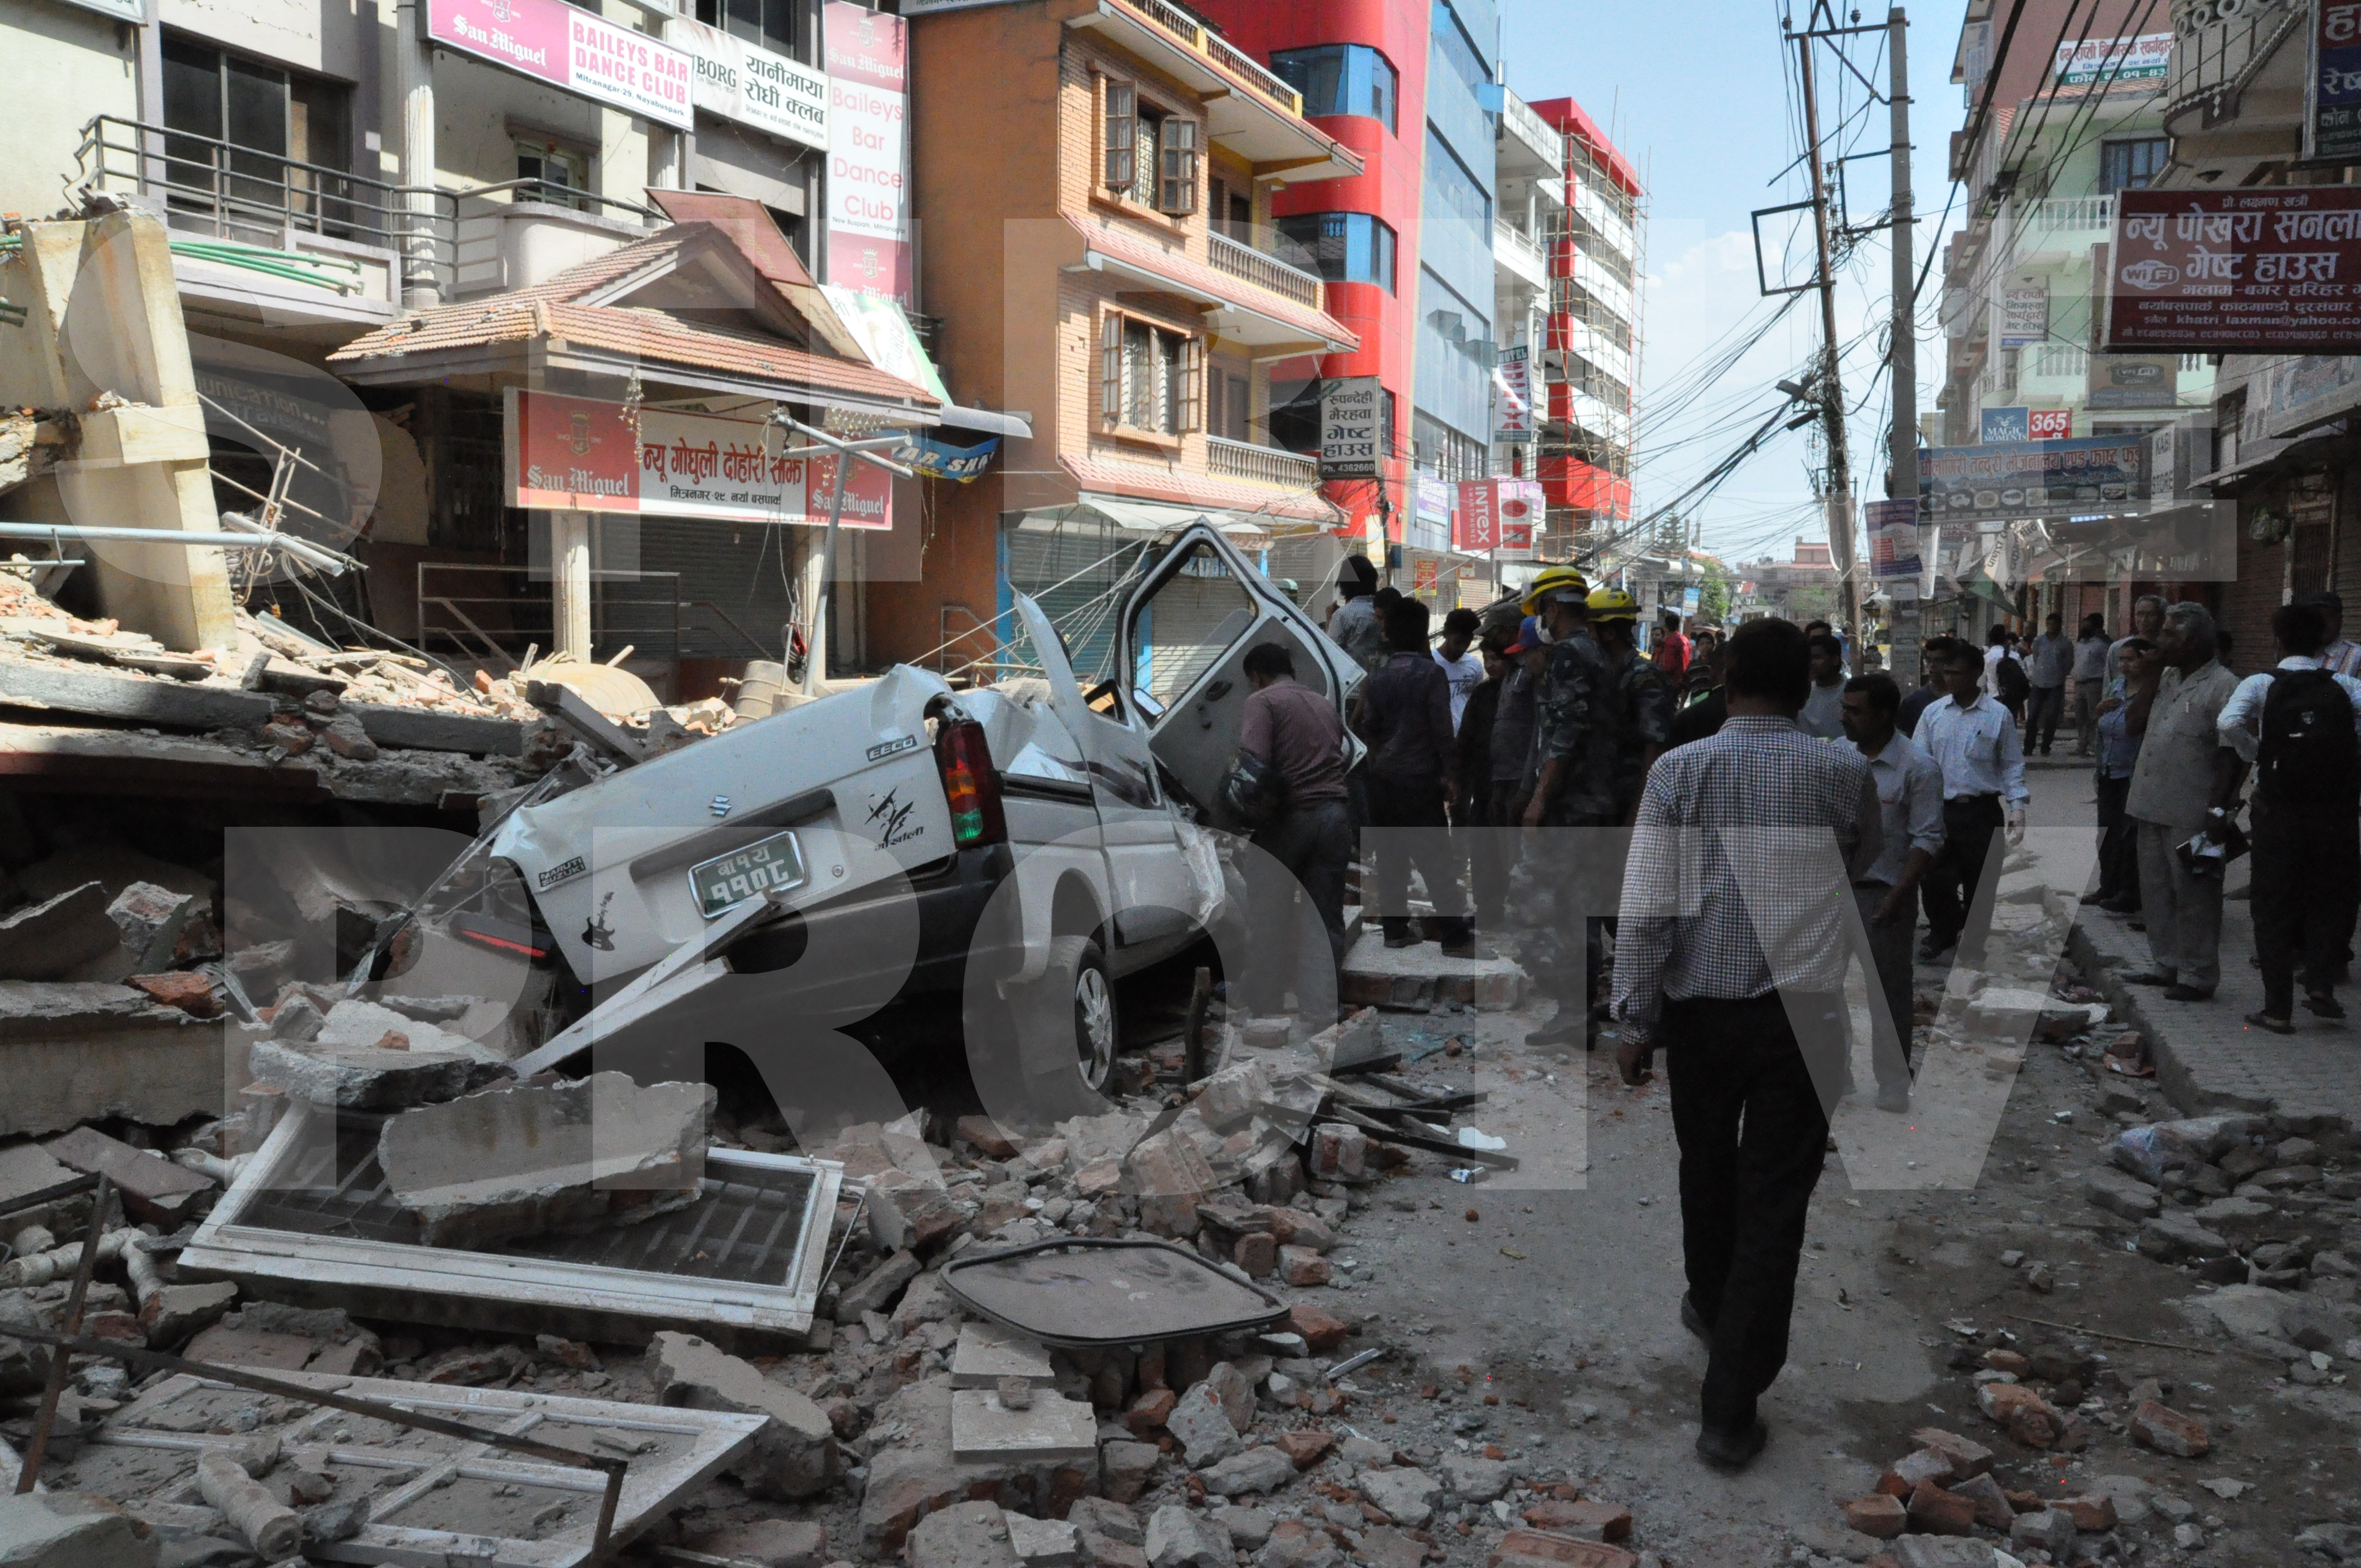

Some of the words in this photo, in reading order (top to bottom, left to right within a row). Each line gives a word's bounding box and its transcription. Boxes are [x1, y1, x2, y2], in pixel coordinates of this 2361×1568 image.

[453, 14, 488, 45] San
[490, 26, 547, 68] Miguel
[573, 20, 648, 68] BAILEYS
[654, 51, 688, 83] BAR
[575, 46, 637, 86] DANCE
[642, 72, 686, 105] CLUB
[693, 55, 737, 88] BORG
[746, 54, 824, 100] यानीमाया
[828, 46, 857, 69] San
[857, 52, 905, 80] Miguel
[636, 92, 685, 117] Nayabuspark
[786, 96, 825, 125] क्लब
[832, 86, 904, 123] Baileys
[852, 125, 885, 151] Bar
[833, 156, 905, 189] Dance
[832, 215, 846, 225] New
[844, 194, 894, 222] Club
[2126, 213, 2168, 251] न्यू
[2177, 202, 2266, 244] पोखरा
[2186, 244, 2248, 280] गेष्ट
[2254, 252, 2340, 282] हाउस
[1498, 347, 1527, 363] HOTEL
[197, 377, 325, 426] unication...
[1329, 406, 1372, 421] भैरहवा
[1326, 424, 1374, 440] गेष्ट
[1987, 426, 2024, 435] MAGIC
[2031, 412, 2068, 432] 365
[1322, 443, 1374, 458] हाउस
[1984, 433, 2027, 442] MOMENTS
[643, 443, 668, 484] न्यू
[1337, 463, 1374, 472] 4362660
[526, 464, 565, 492] San
[567, 467, 630, 500] Miguel
[869, 738, 914, 760] EECO
[540, 858, 583, 880] MARUTI
[541, 863, 584, 886] SUZUKI
[710, 858, 790, 903] ११०८
[716, 858, 737, 876] बा
